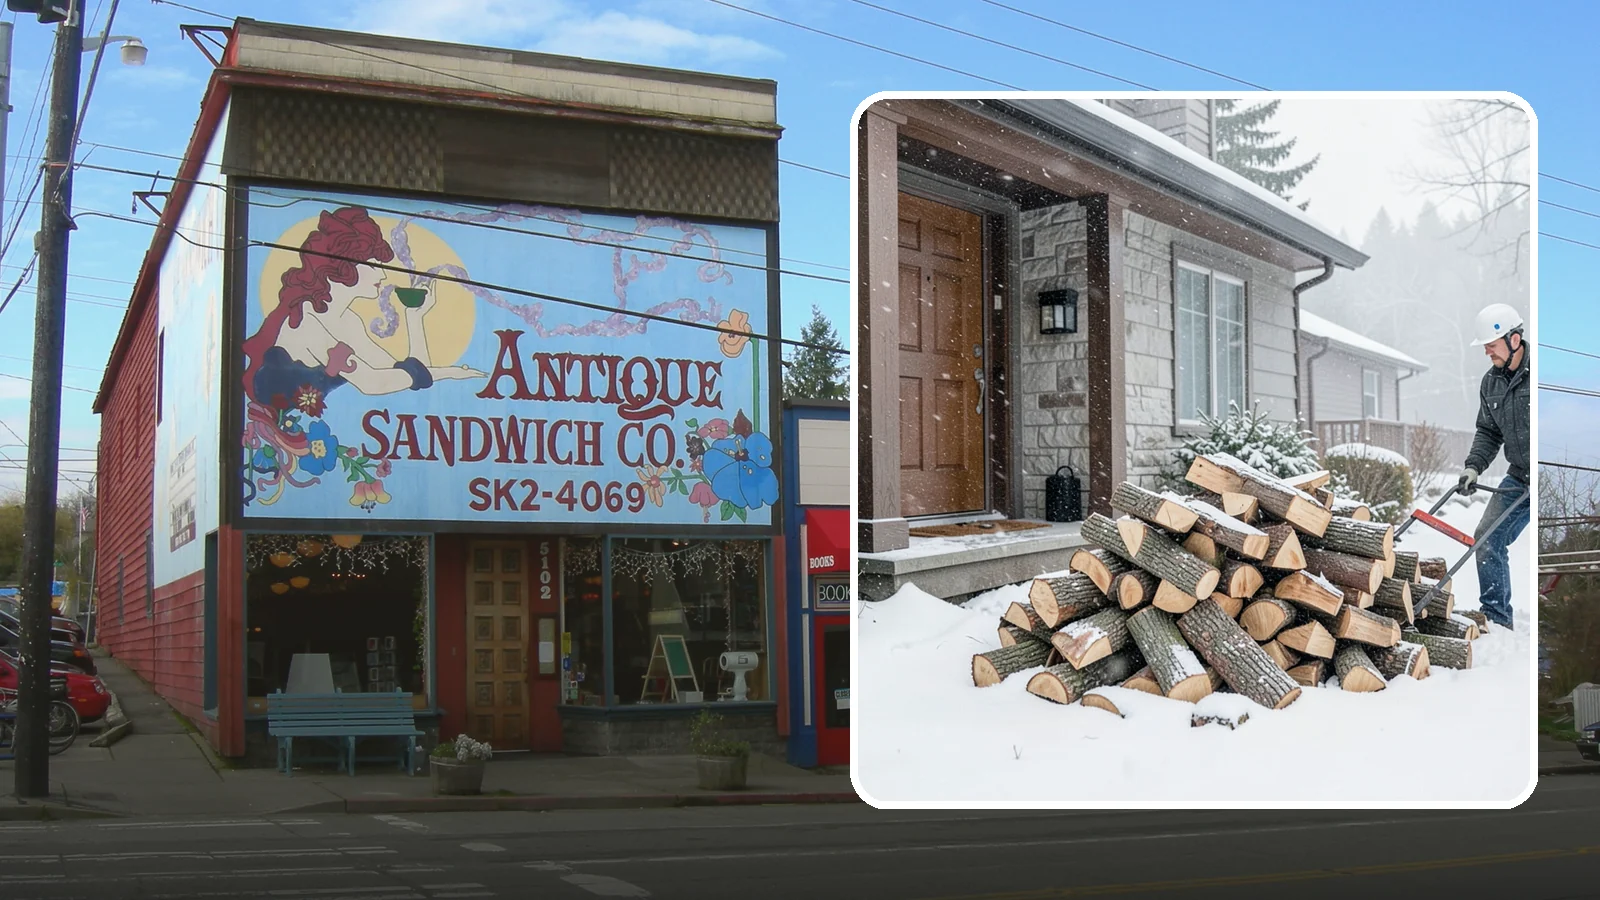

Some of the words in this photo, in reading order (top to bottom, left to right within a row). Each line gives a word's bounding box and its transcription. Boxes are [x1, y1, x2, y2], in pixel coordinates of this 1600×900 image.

[475, 329, 723, 421] ANTIQUE
[361, 408, 605, 467] SANDWICH
[617, 422, 685, 468] CO.
[468, 477, 646, 513] SK2-4069
[540, 541, 551, 600] 5102
[809, 555, 835, 569] BOOKS
